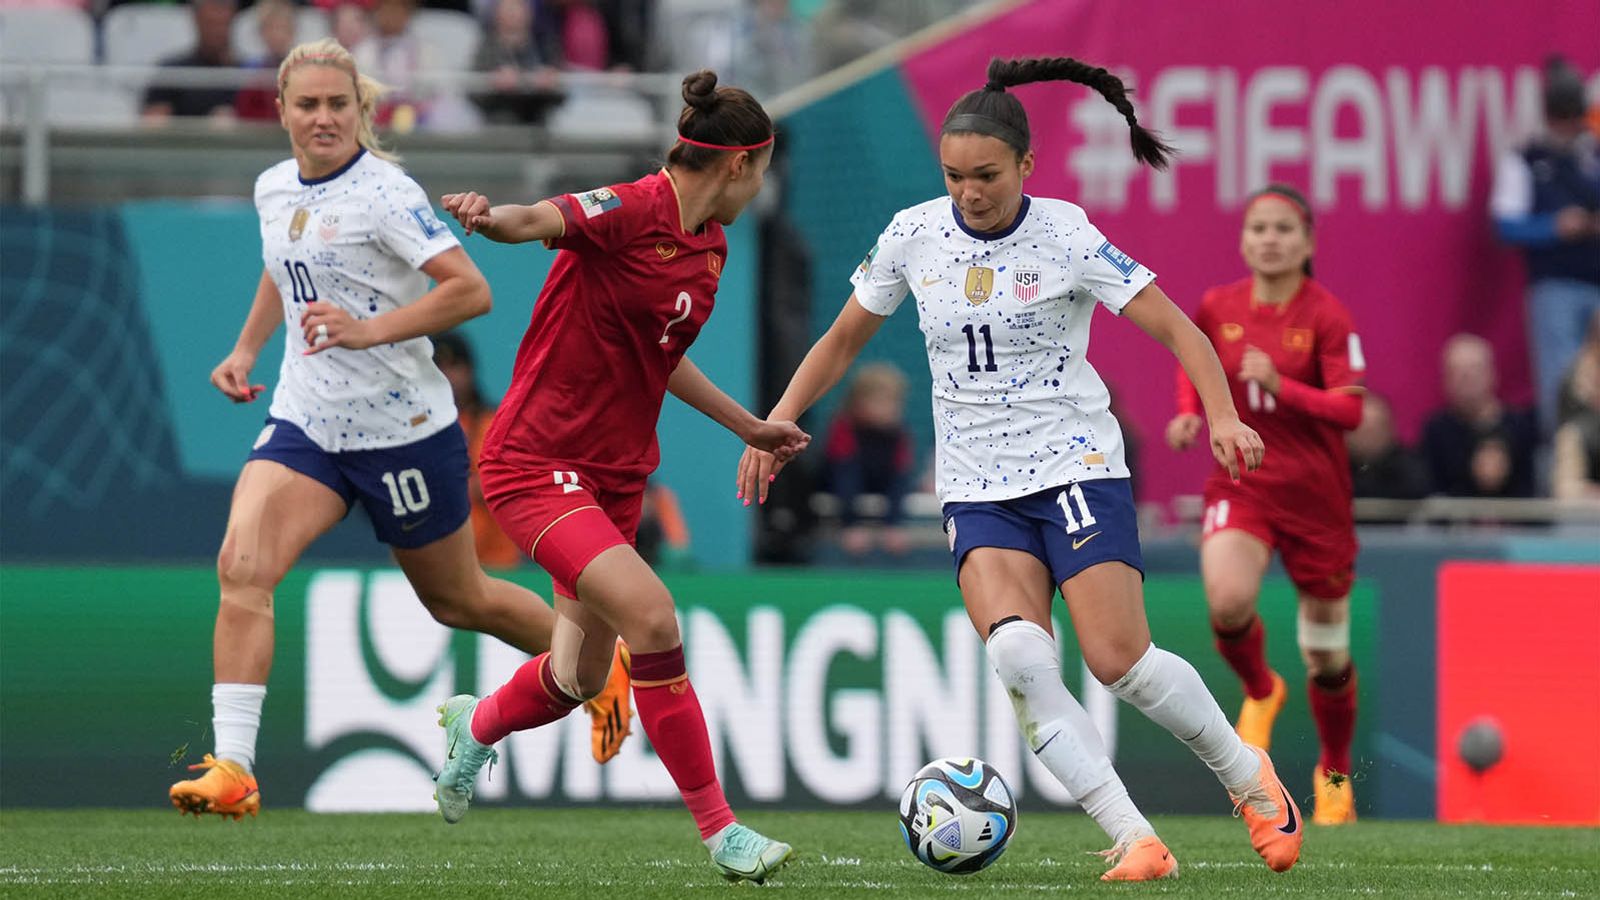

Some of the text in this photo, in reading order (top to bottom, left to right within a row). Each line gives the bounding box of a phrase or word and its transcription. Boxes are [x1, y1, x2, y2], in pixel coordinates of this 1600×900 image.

[284, 259, 318, 302] 10
[1016, 272, 1039, 286] USA
[659, 291, 692, 344] 2
[962, 324, 998, 372] 11
[381, 468, 430, 516] 10
[1056, 482, 1097, 535] 11
